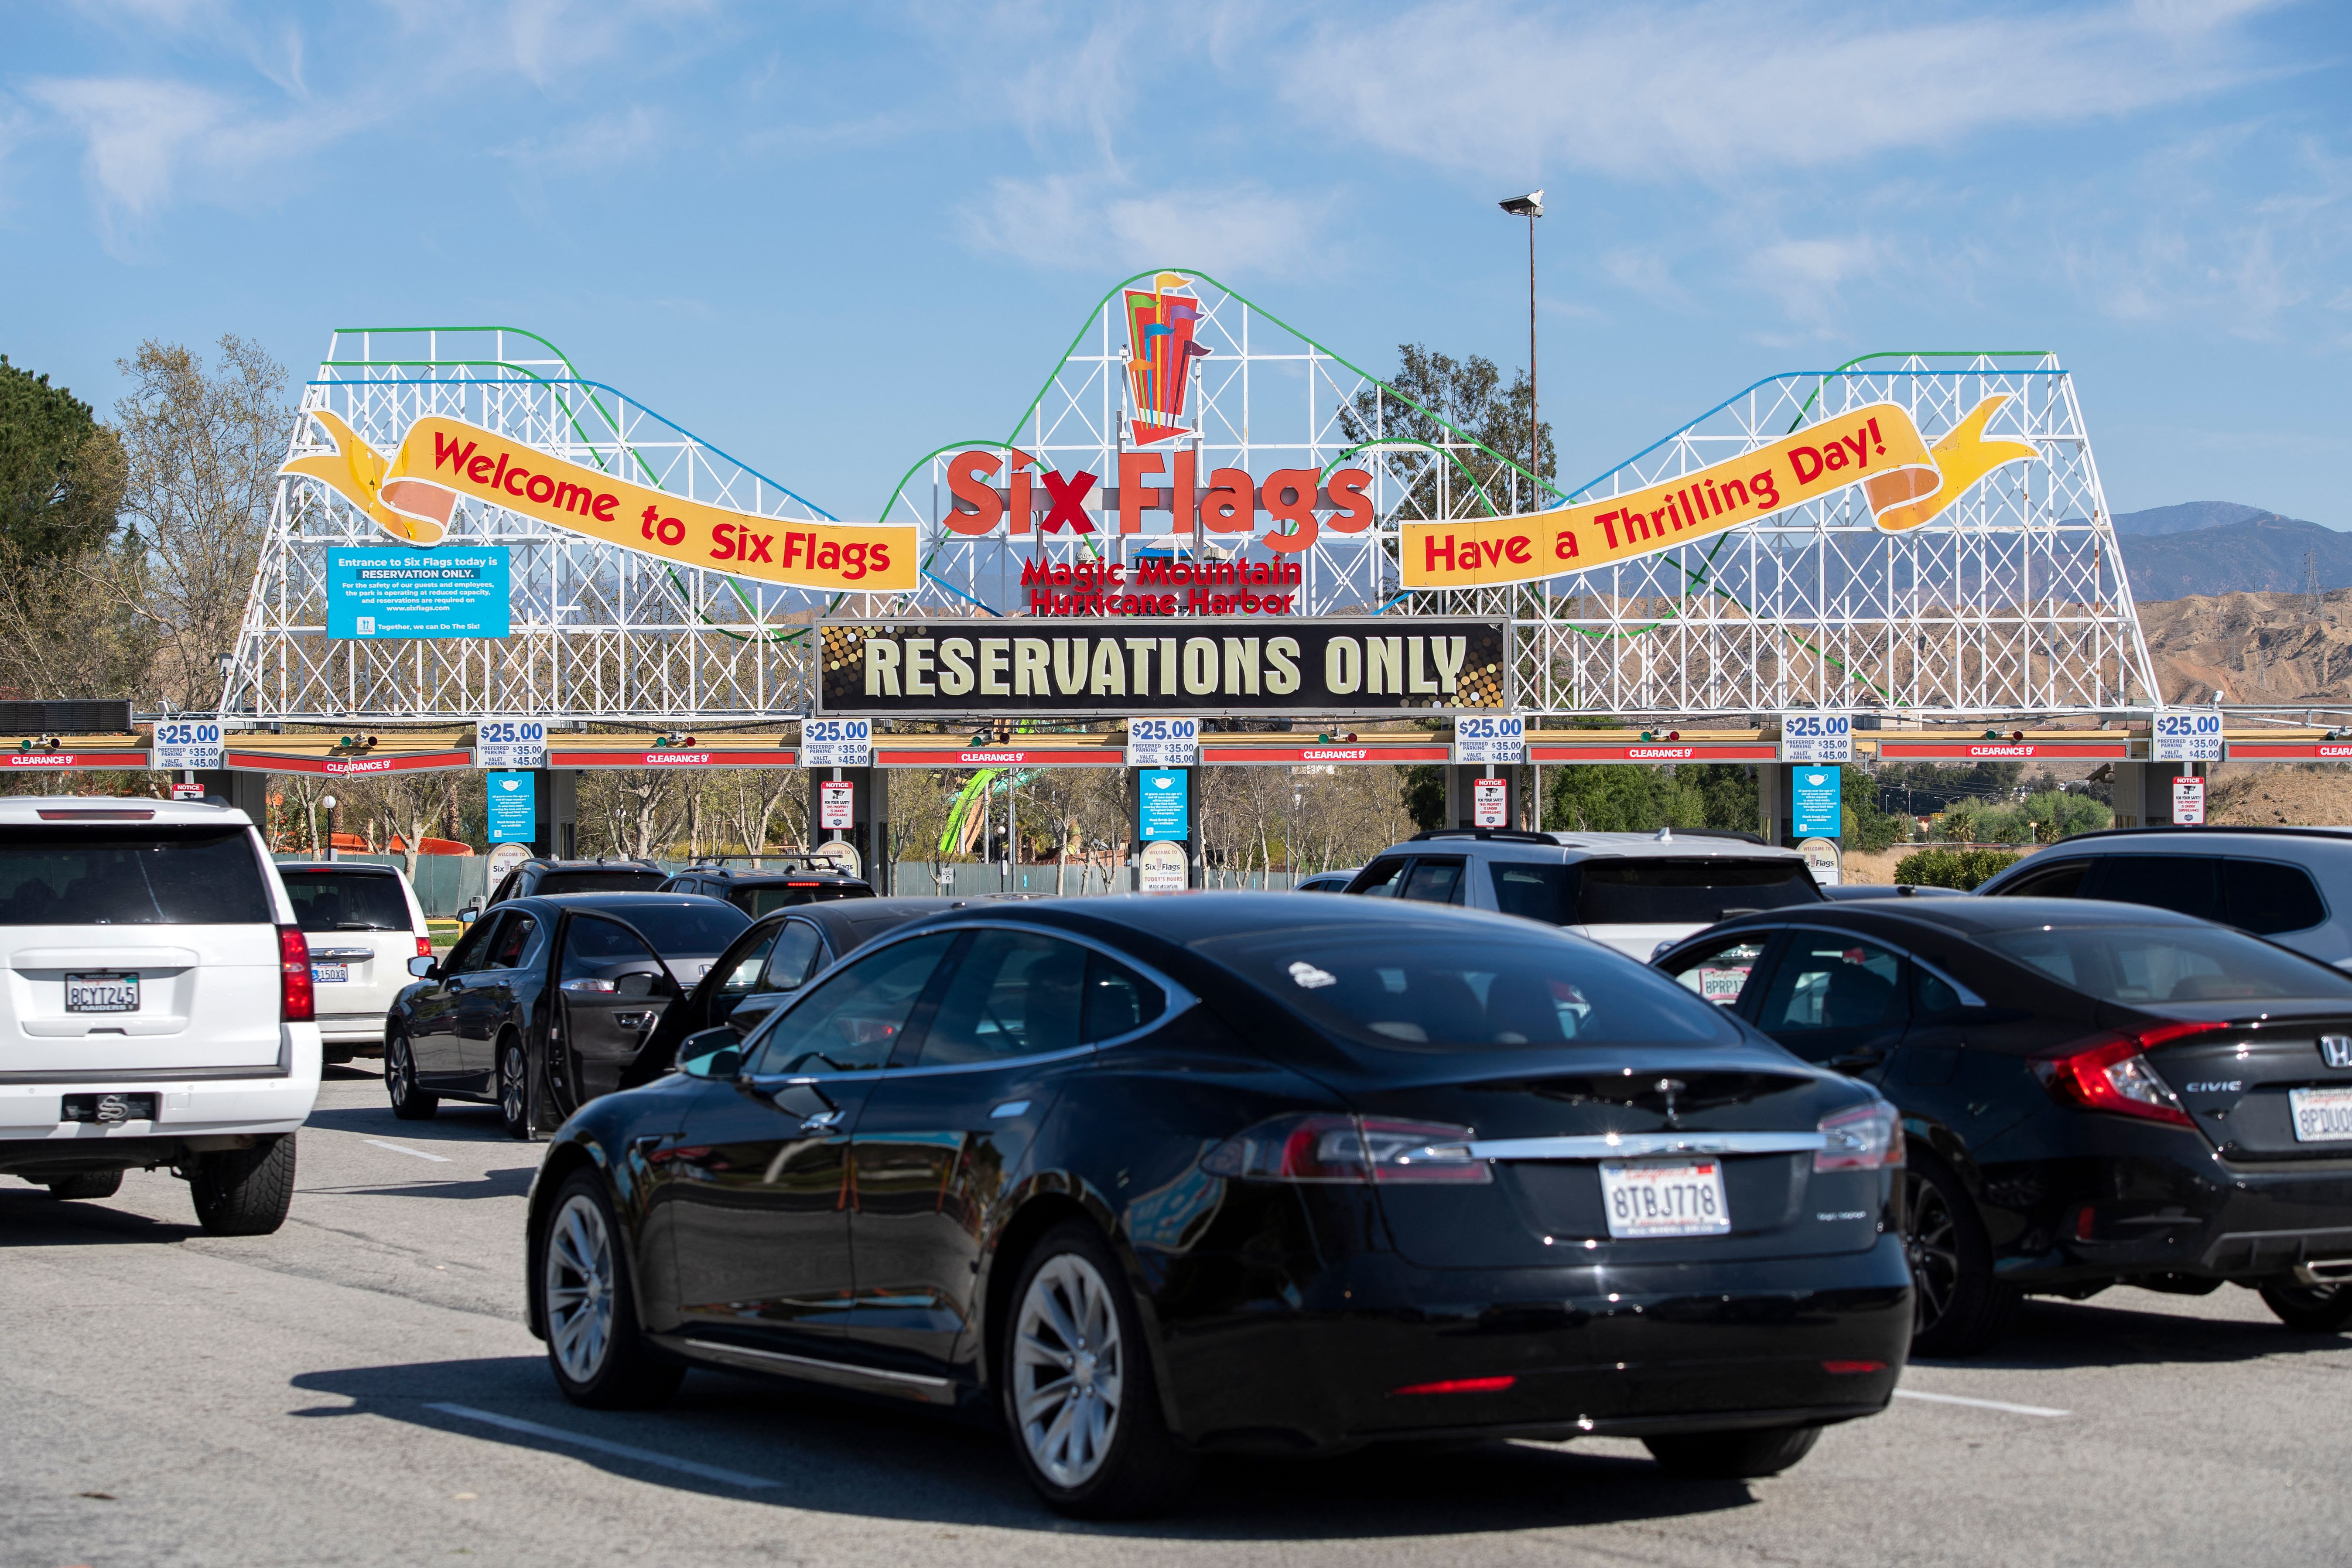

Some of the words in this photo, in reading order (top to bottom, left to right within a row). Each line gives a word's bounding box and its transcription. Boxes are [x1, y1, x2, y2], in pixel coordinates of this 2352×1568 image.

[1425, 535, 1532, 572] Have
[1556, 531, 1579, 560] a
[1594, 470, 1780, 550] Thrilling
[1787, 417, 1886, 486] Day!
[943, 448, 1097, 535] Six
[1119, 450, 1374, 553] Flags
[435, 431, 620, 522] Welcome
[641, 505, 685, 546] to
[710, 523, 773, 563] Six
[783, 532, 890, 580] Flags
[404, 557, 420, 566] Six
[424, 558, 452, 568] Flags
[455, 557, 486, 567] today
[489, 557, 497, 565] is
[362, 570, 438, 578] RESERVATION
[1020, 556, 1125, 593] Magic
[1136, 554, 1301, 586] Mountain
[1031, 588, 1176, 615] Hurricane
[1188, 588, 1295, 615] Harbor
[862, 636, 1301, 697] RESERVATIONS
[1326, 635, 1467, 696] ONLY
[1460, 719, 1521, 738] $25.00
[1786, 717, 1848, 736] $25.00
[2157, 716, 2219, 735] $25.00
[157, 725, 219, 744] $25.00
[481, 723, 542, 741] $25.00
[806, 721, 867, 740] $25.00
[1132, 721, 1194, 740] $25.00
[1164, 744, 1193, 752] $35.00
[1491, 741, 1520, 750] $35.00
[1818, 740, 1847, 748] $35.00
[2189, 739, 2218, 748] $35.00
[189, 748, 218, 756] $35.00
[513, 746, 541, 755] $35.00
[838, 745, 866, 753] $35.00
[1629, 749, 1683, 758] CLEARANCE
[1685, 748, 1693, 757] 9'
[1971, 747, 2025, 755] CLEARANCE
[2026, 747, 2034, 755] 9'
[701, 754, 709, 762] 9'
[1016, 753, 1024, 761] 9'
[1164, 755, 1193, 763] $45.00
[1303, 751, 1357, 759] CLEARANCE
[1359, 750, 1366, 758] 9'
[1491, 752, 1520, 761] $45.00
[1818, 751, 1847, 760] $45.00
[2189, 750, 2218, 759] $45.00
[189, 759, 218, 768] $45.00
[513, 757, 541, 765] $45.00
[838, 755, 866, 764] $45.00
[327, 761, 383, 772] CLEARANCE
[383, 760, 391, 769] 9'
[71, 987, 134, 1004] 8CYT245
[2186, 1080, 2241, 1092] CIVIC
[1613, 1183, 1715, 1217] 8TBJ778
